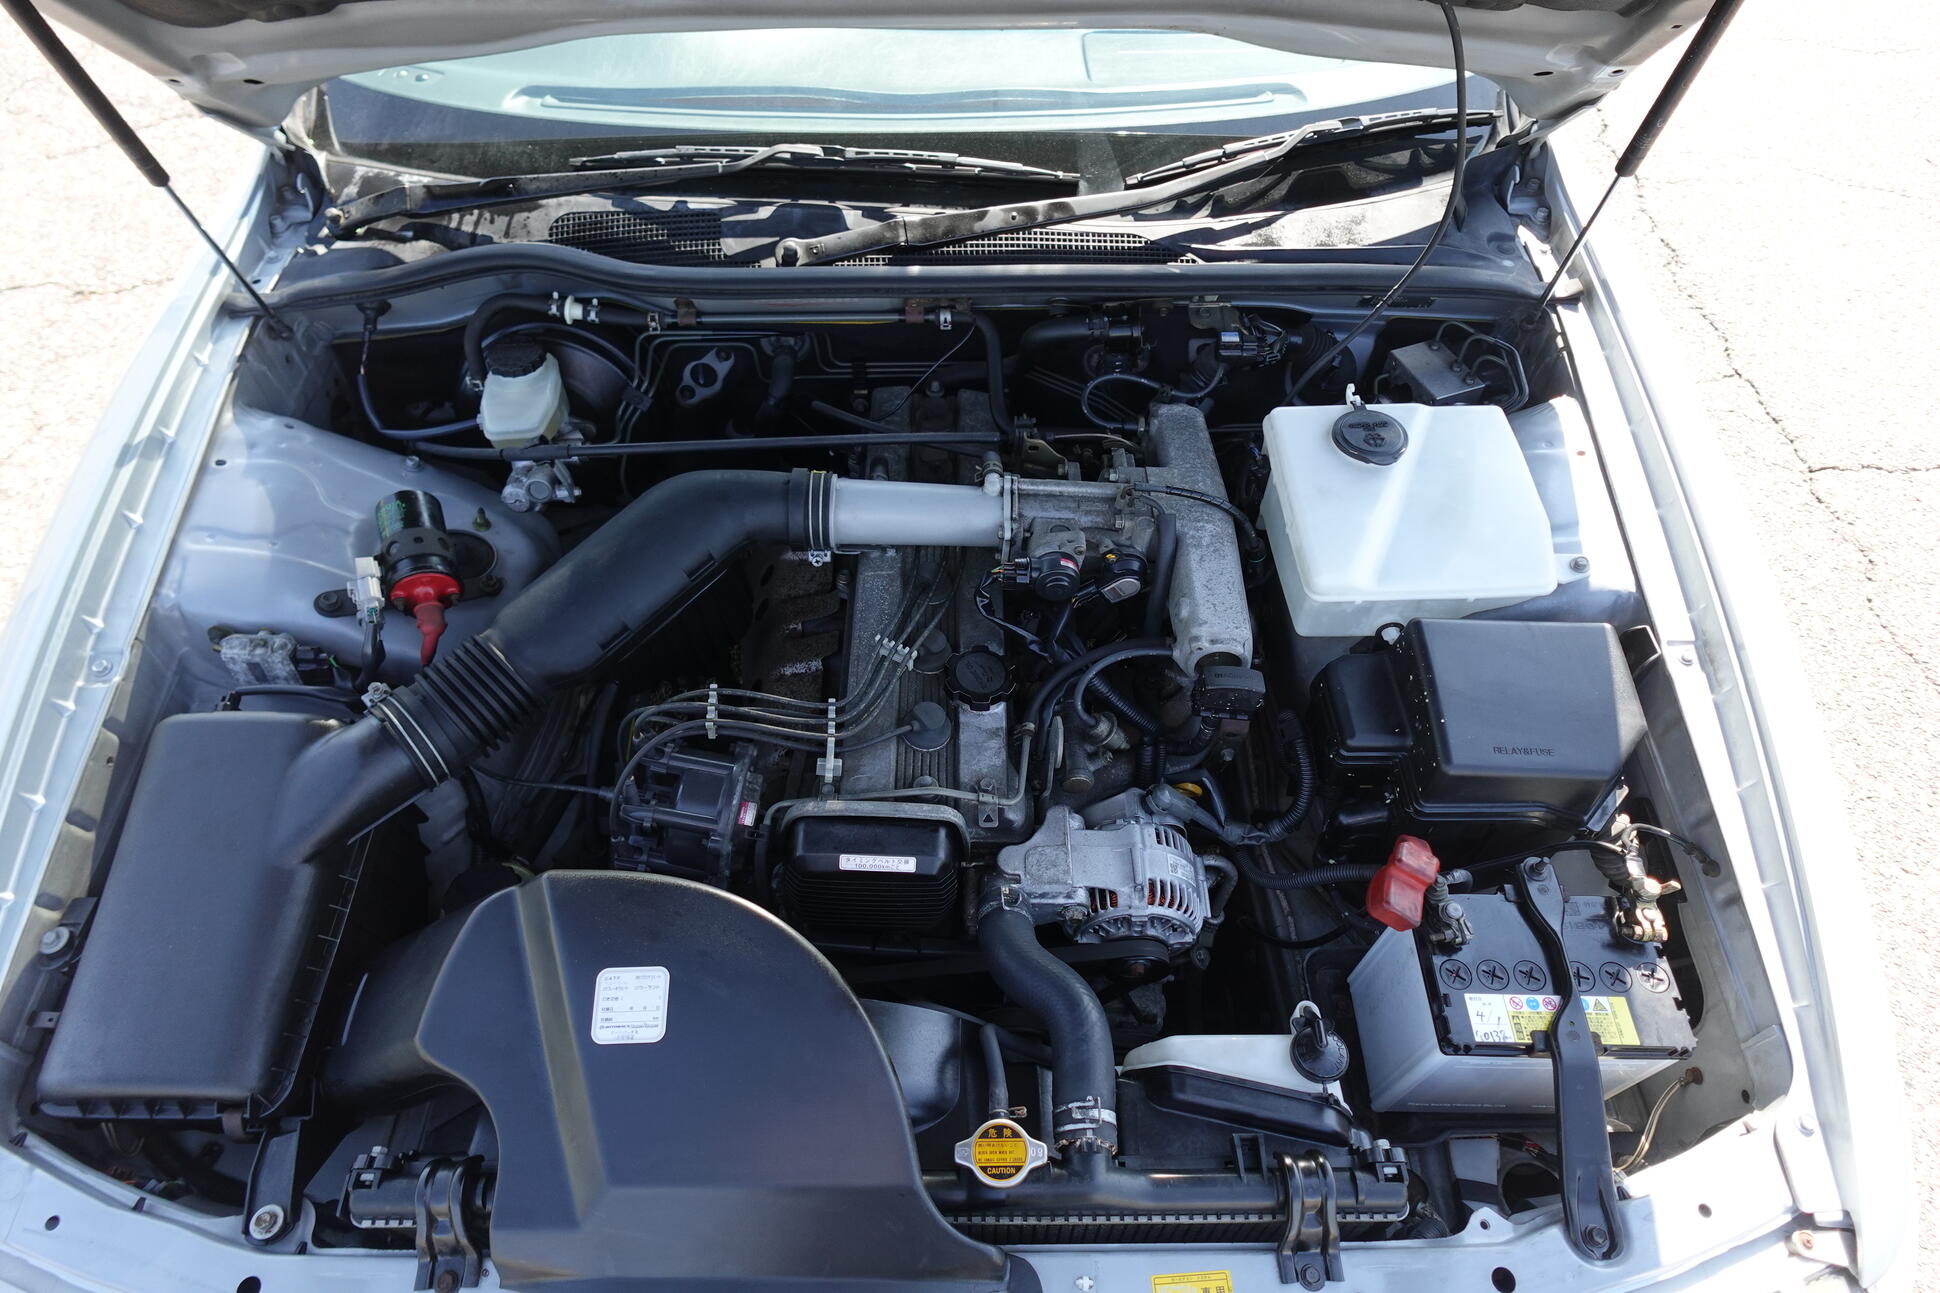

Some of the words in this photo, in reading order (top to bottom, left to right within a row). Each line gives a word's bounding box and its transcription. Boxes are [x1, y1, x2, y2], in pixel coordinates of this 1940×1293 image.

[1493, 746, 1555, 756] RELAY&FUSE
[988, 1128, 1012, 1138] 危険
[986, 1167, 1016, 1175] CAUTION
